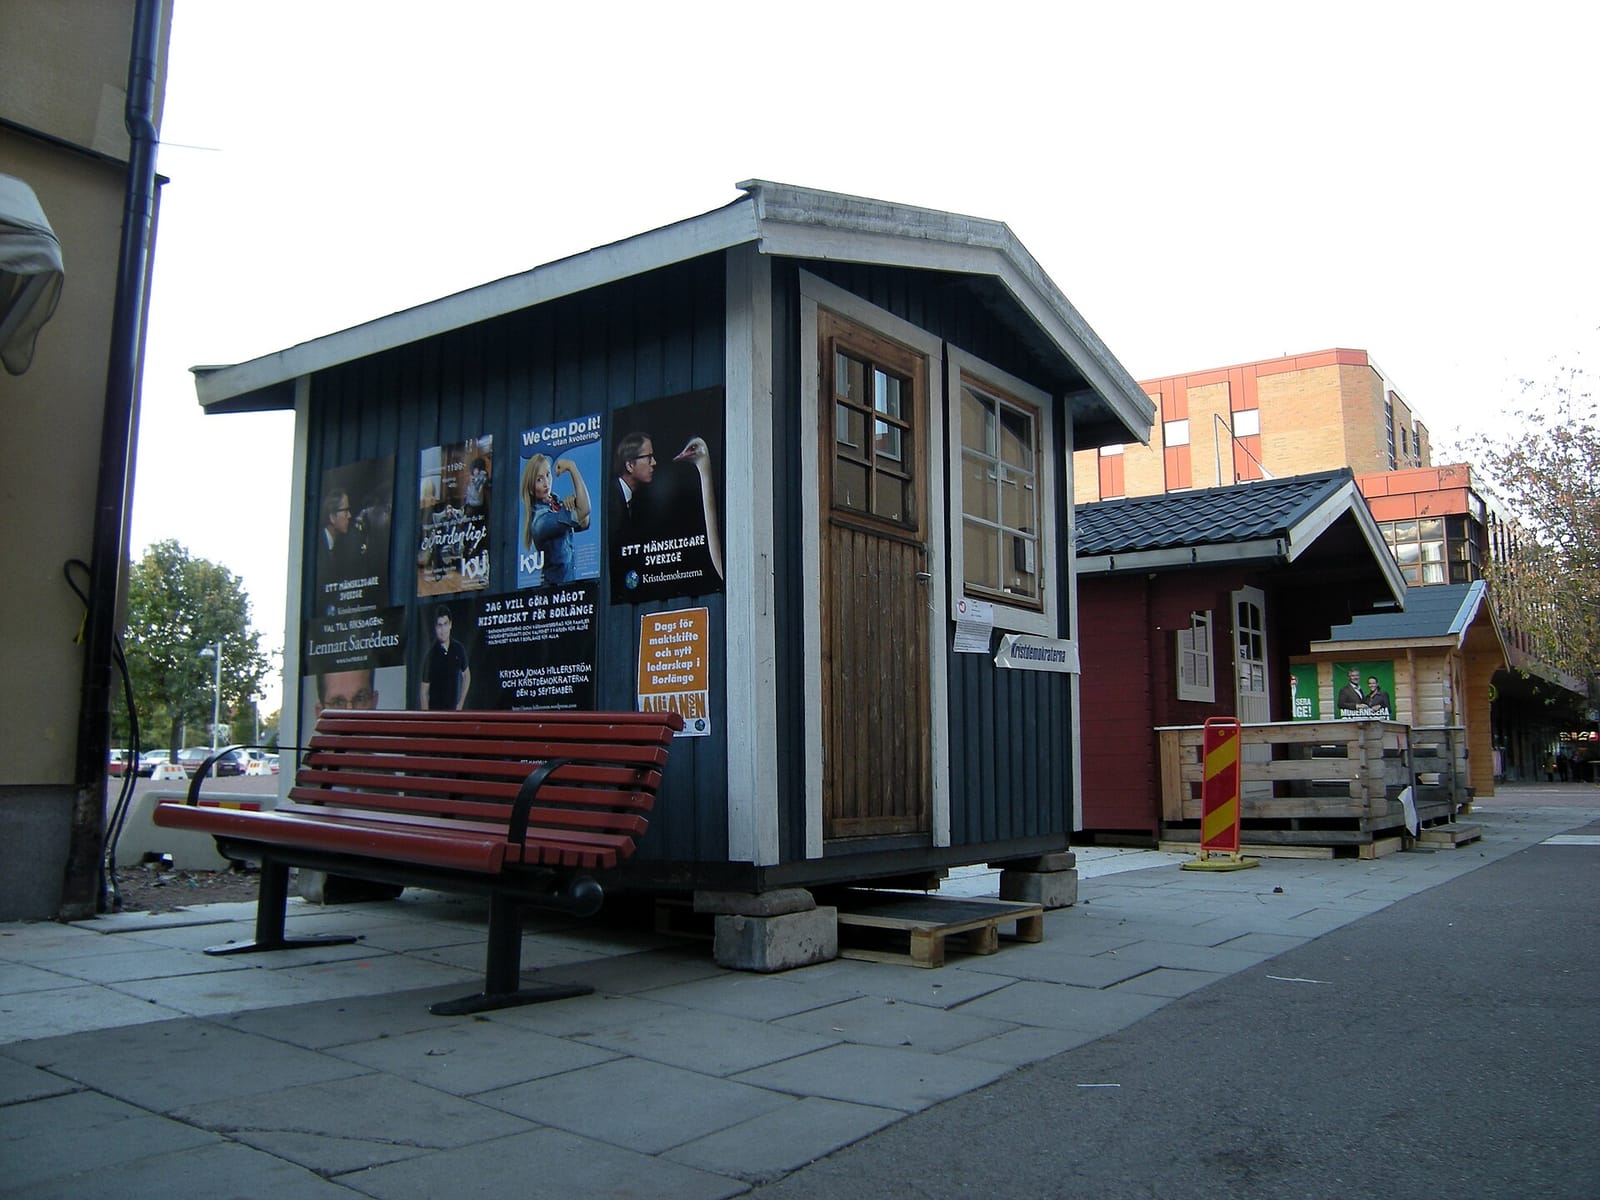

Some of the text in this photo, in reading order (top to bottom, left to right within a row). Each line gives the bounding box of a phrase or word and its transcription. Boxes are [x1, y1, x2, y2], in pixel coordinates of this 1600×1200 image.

[523, 415, 601, 446] We Can Do It!
[552, 438, 568, 447] utan
[621, 534, 705, 556] ETT MÄNSKLIGARE
[645, 551, 682, 566] SVERIGE
[642, 568, 703, 584] Kristdemokraterna
[485, 590, 586, 613] JAG VILL GÖRA NÅGOT
[478, 611, 528, 627] HISTORISKT
[532, 608, 546, 621] FÖR
[549, 604, 594, 619] BORLÄNGE
[336, 622, 348, 631] TILL
[654, 619, 694, 633] Dags för
[309, 630, 399, 656] Lennart Sacrédeus
[649, 631, 699, 645] maktskifte
[655, 646, 692, 658] och nytt
[1010, 642, 1066, 663] Kristdemokraterna
[499, 662, 592, 679] KRYSSA JONAS HILLERSTRÖM
[647, 657, 700, 672] ledarskap i
[502, 675, 590, 689] OCH KRISTDEMOKRATERNA
[652, 673, 695, 685] Borlänge
[516, 689, 529, 698] DEN
[537, 685, 574, 697] SEPTEMBER
